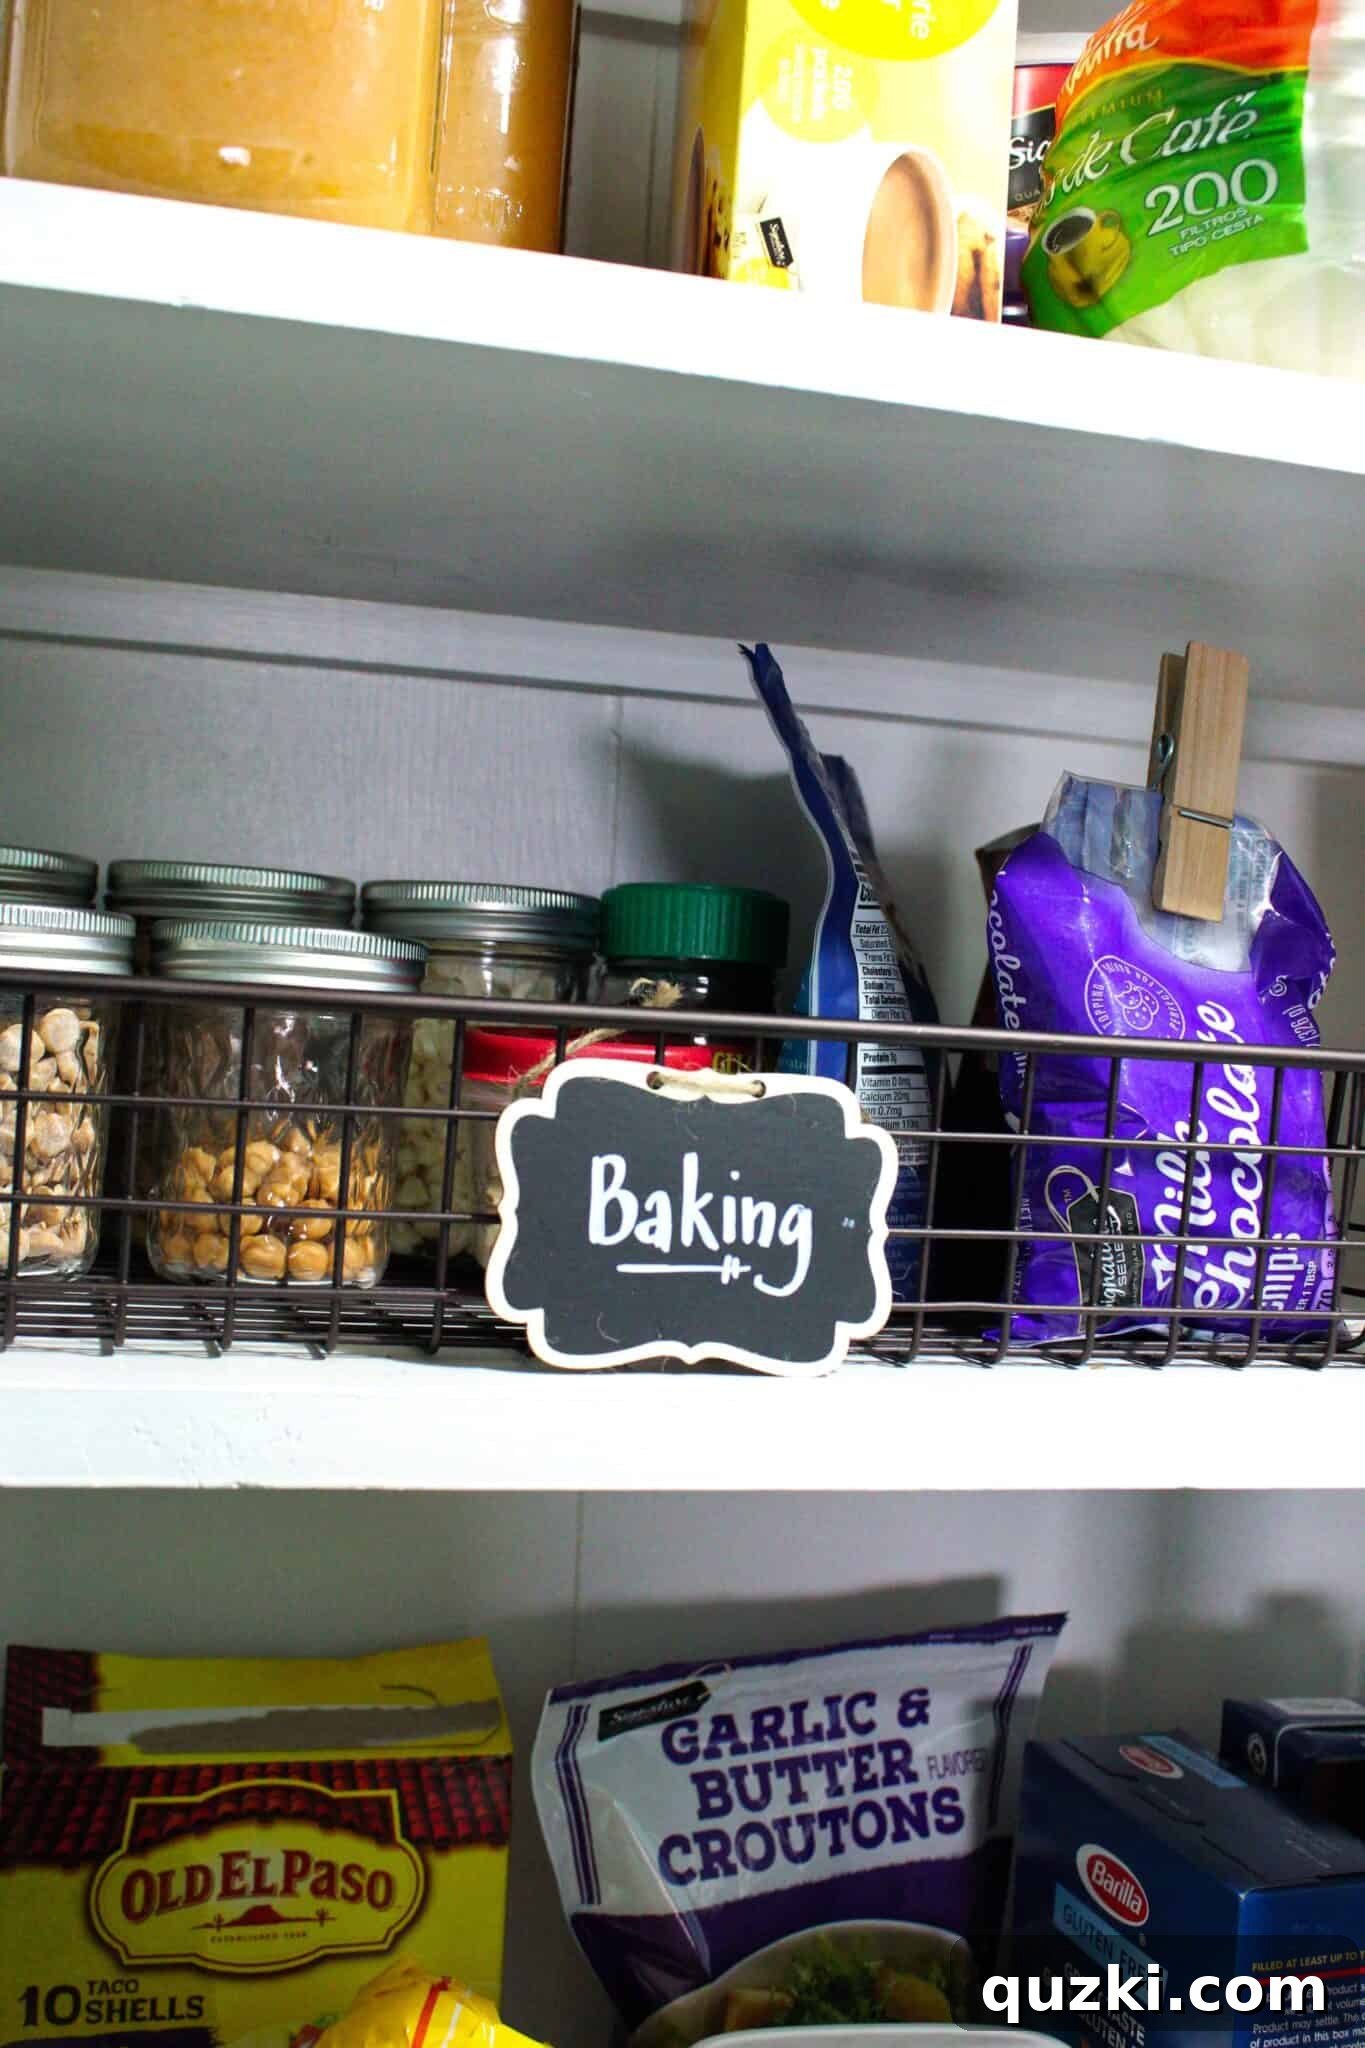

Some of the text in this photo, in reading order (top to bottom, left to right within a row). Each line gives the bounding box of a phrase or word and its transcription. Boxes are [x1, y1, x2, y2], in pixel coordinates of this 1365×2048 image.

[1062, 129, 1112, 193] de
[1120, 92, 1257, 165] Café
[1144, 159, 1279, 236] 200
[1169, 215, 1264, 256] TIPO CESTA
[1180, 208, 1248, 239] FILTROS
[860, 1092, 892, 1103] Calcium
[861, 1077, 891, 1087] Vitamin
[588, 1152, 813, 1297] Baking
[1151, 1118, 1217, 1291] Milk
[1304, 1259, 1318, 1286] TBSP
[662, 1688, 930, 1765] GARLIC &
[691, 1737, 918, 1820] BUTTER
[659, 1788, 965, 1885] CROUTONS
[121, 1866, 213, 1924] OLD
[217, 1850, 276, 1899] EL
[1092, 1860, 1142, 1915] Barilla
[1063, 1904, 1114, 1960] GLUTEN
[1252, 1961, 1283, 1973] FILLED
[1286, 1959, 1297, 1969] AT
[1300, 1955, 1328, 1966] LEAST
[1330, 1953, 1342, 1963] UP
[1345, 1952, 1358, 1960] TO
[19, 1985, 81, 2026] 10
[88, 1980, 139, 1995] TACO
[86, 1995, 204, 2024] SHELLS
[1253, 2022, 1289, 2033] Product
[1292, 2020, 1311, 2030] may
[1250, 2039, 1260, 2048] of
[1264, 2035, 1299, 2048] product
[1314, 2031, 1329, 2040] this
